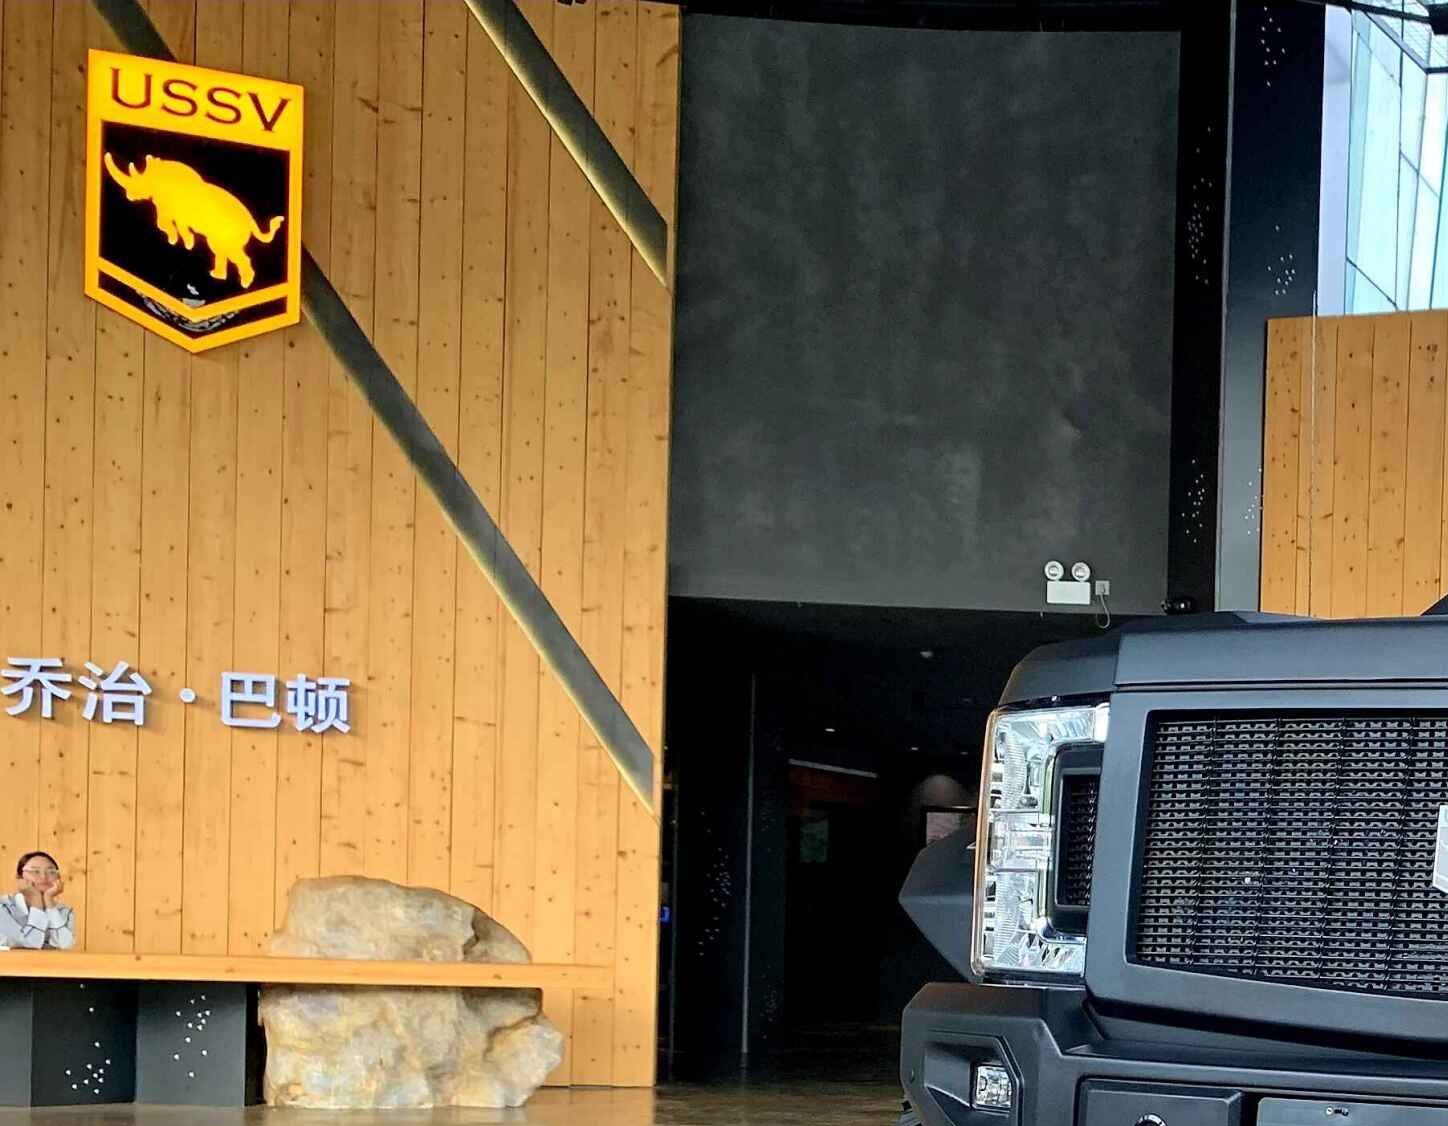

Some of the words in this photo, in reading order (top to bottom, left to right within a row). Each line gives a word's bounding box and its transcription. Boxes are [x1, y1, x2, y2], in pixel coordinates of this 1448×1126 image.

[110, 67, 291, 133] USSV
[0, 656, 351, 734] 乔治·巴顿
